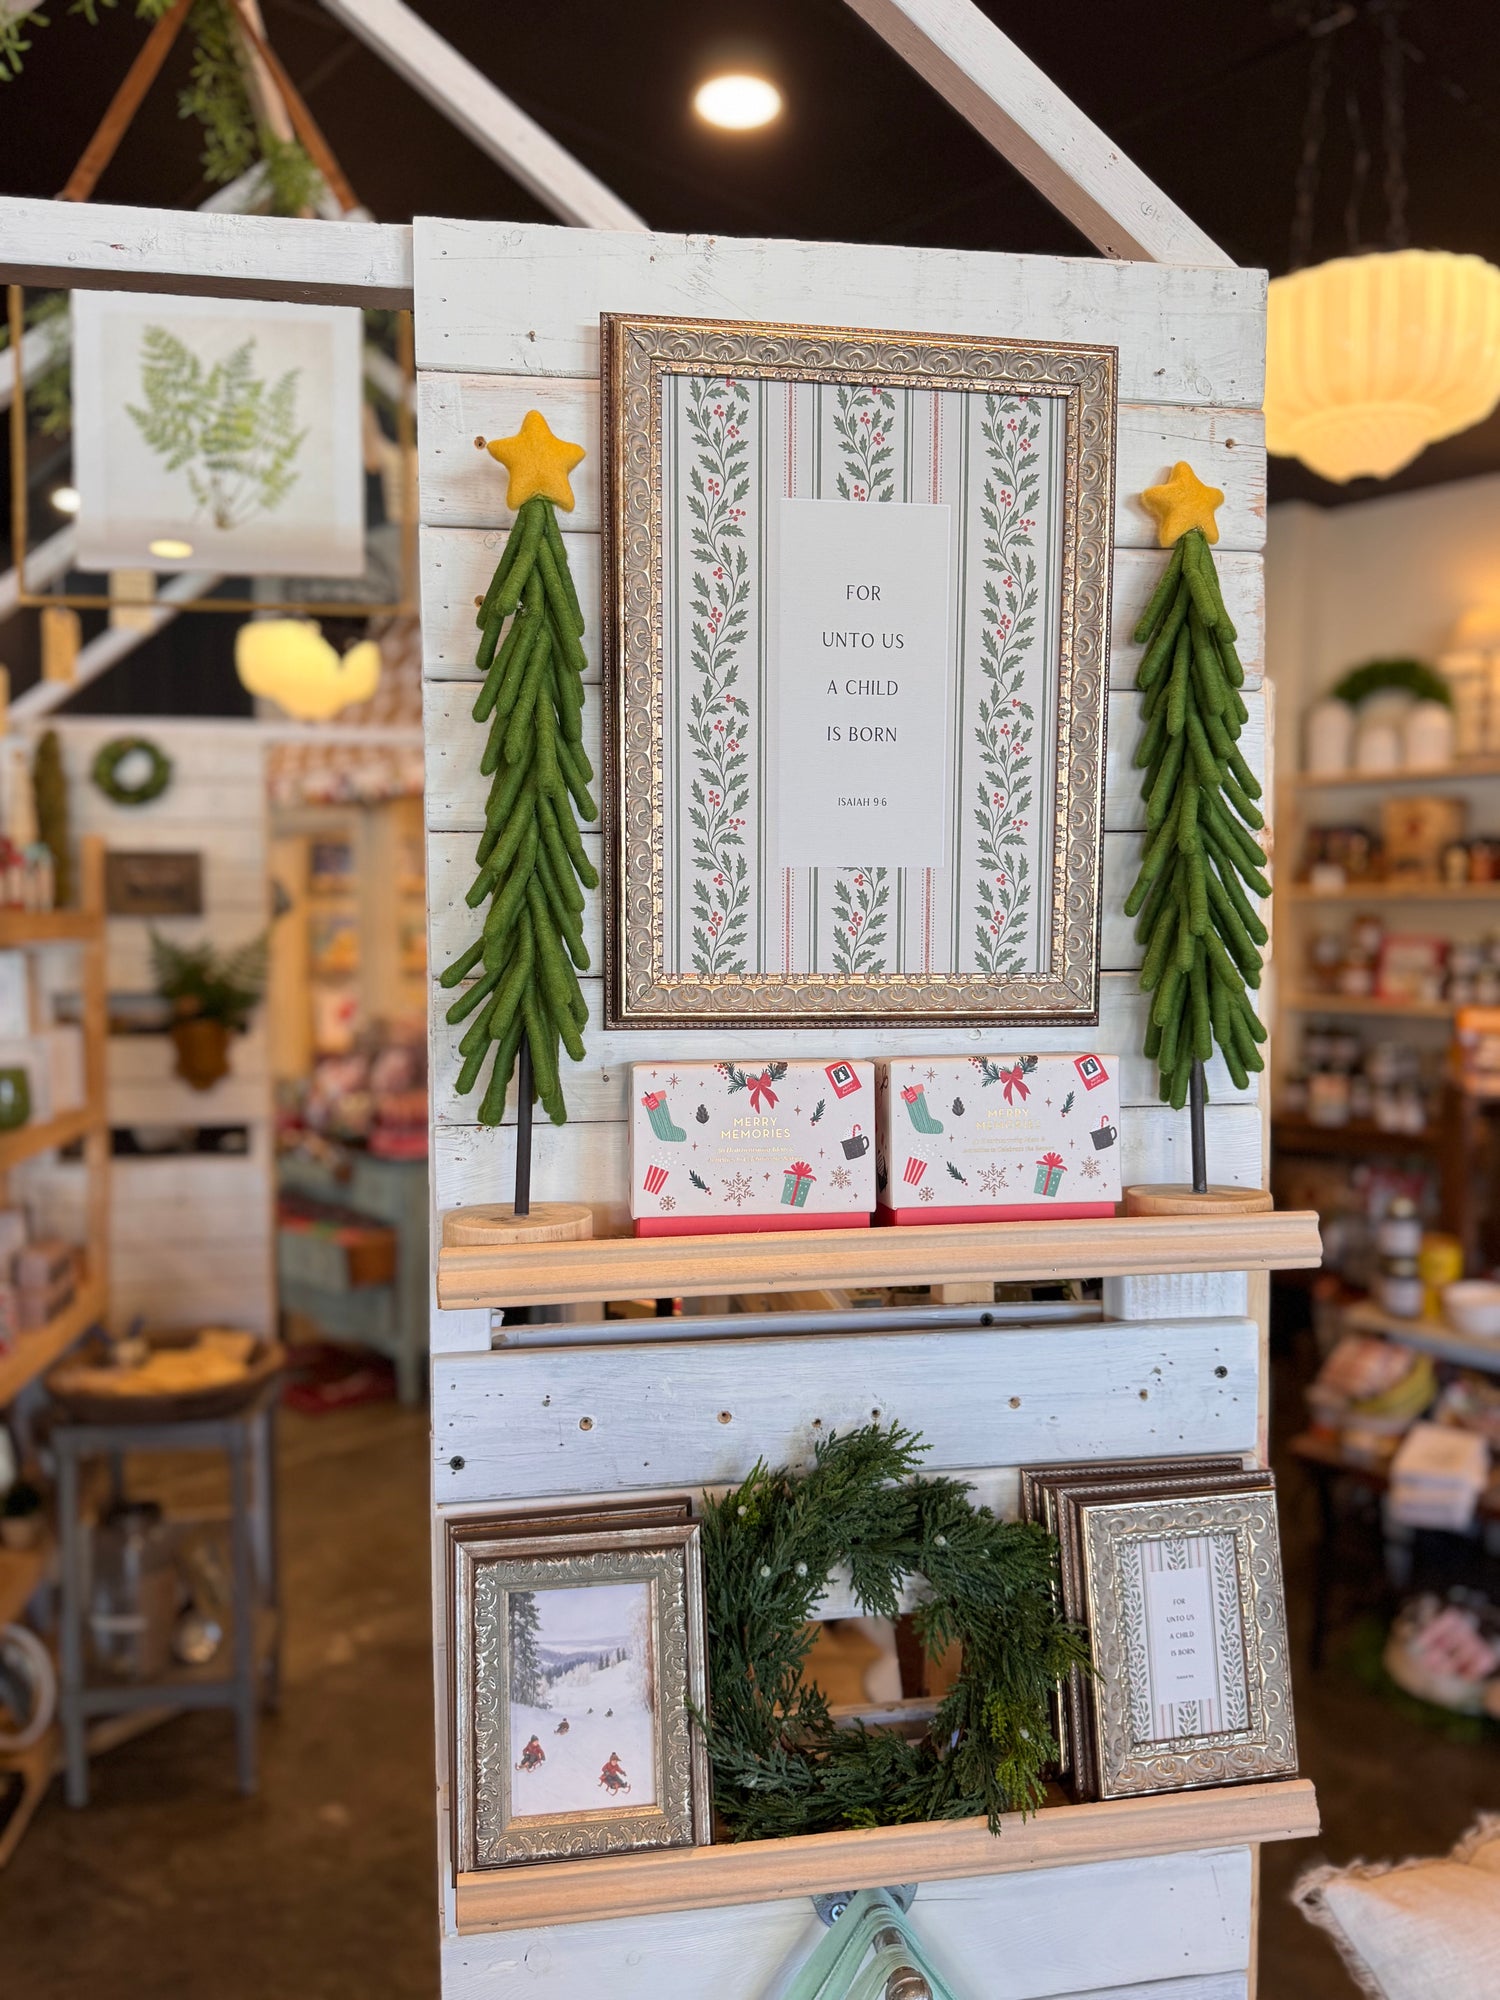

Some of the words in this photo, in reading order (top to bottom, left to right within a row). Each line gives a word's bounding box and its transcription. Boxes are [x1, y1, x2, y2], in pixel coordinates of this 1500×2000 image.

[846, 584, 881, 601] FOR
[822, 631, 875, 648] UNTO
[882, 633, 905, 649] US
[826, 679, 838, 695] A
[845, 680, 899, 696] CHILD
[827, 726, 841, 741] IS
[848, 726, 897, 742] BORN
[838, 797, 870, 807] ISAIAH
[733, 1116, 778, 1127] MERRY
[720, 1128, 791, 1139] MEMORIES
[1166, 1615, 1185, 1623] UNTO
[1175, 1631, 1195, 1639] CHILD
[1178, 1648, 1196, 1656] BORN
